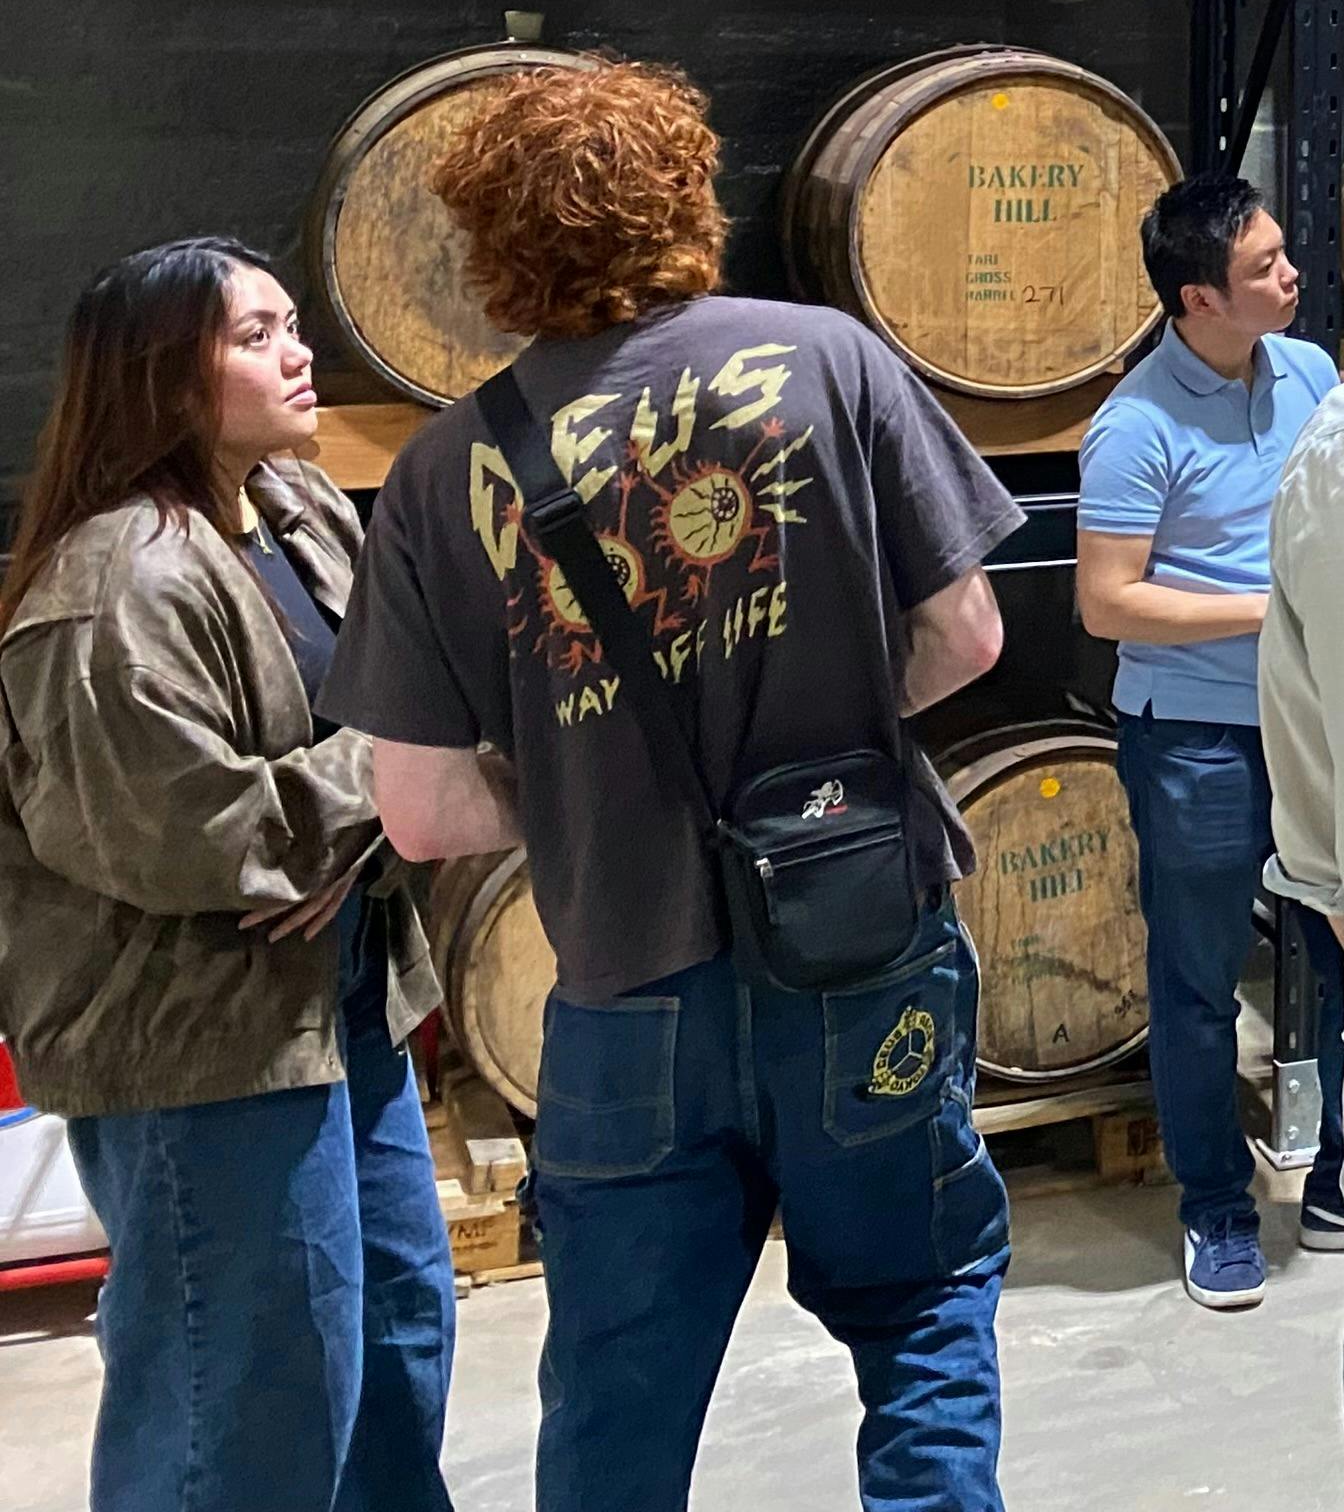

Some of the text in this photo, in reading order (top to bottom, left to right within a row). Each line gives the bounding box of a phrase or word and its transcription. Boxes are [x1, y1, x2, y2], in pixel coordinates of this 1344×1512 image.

[968, 164, 1084, 189] BAKERY
[994, 198, 1057, 223] HILL
[965, 271, 1012, 285] GROSS
[1022, 285, 1064, 306] 271
[470, 343, 797, 581] DEUS
[556, 675, 620, 727] WAY
[1001, 830, 1111, 875] BAKERY
[1030, 868, 1084, 902] HILL
[1052, 1023, 1070, 1043] A
